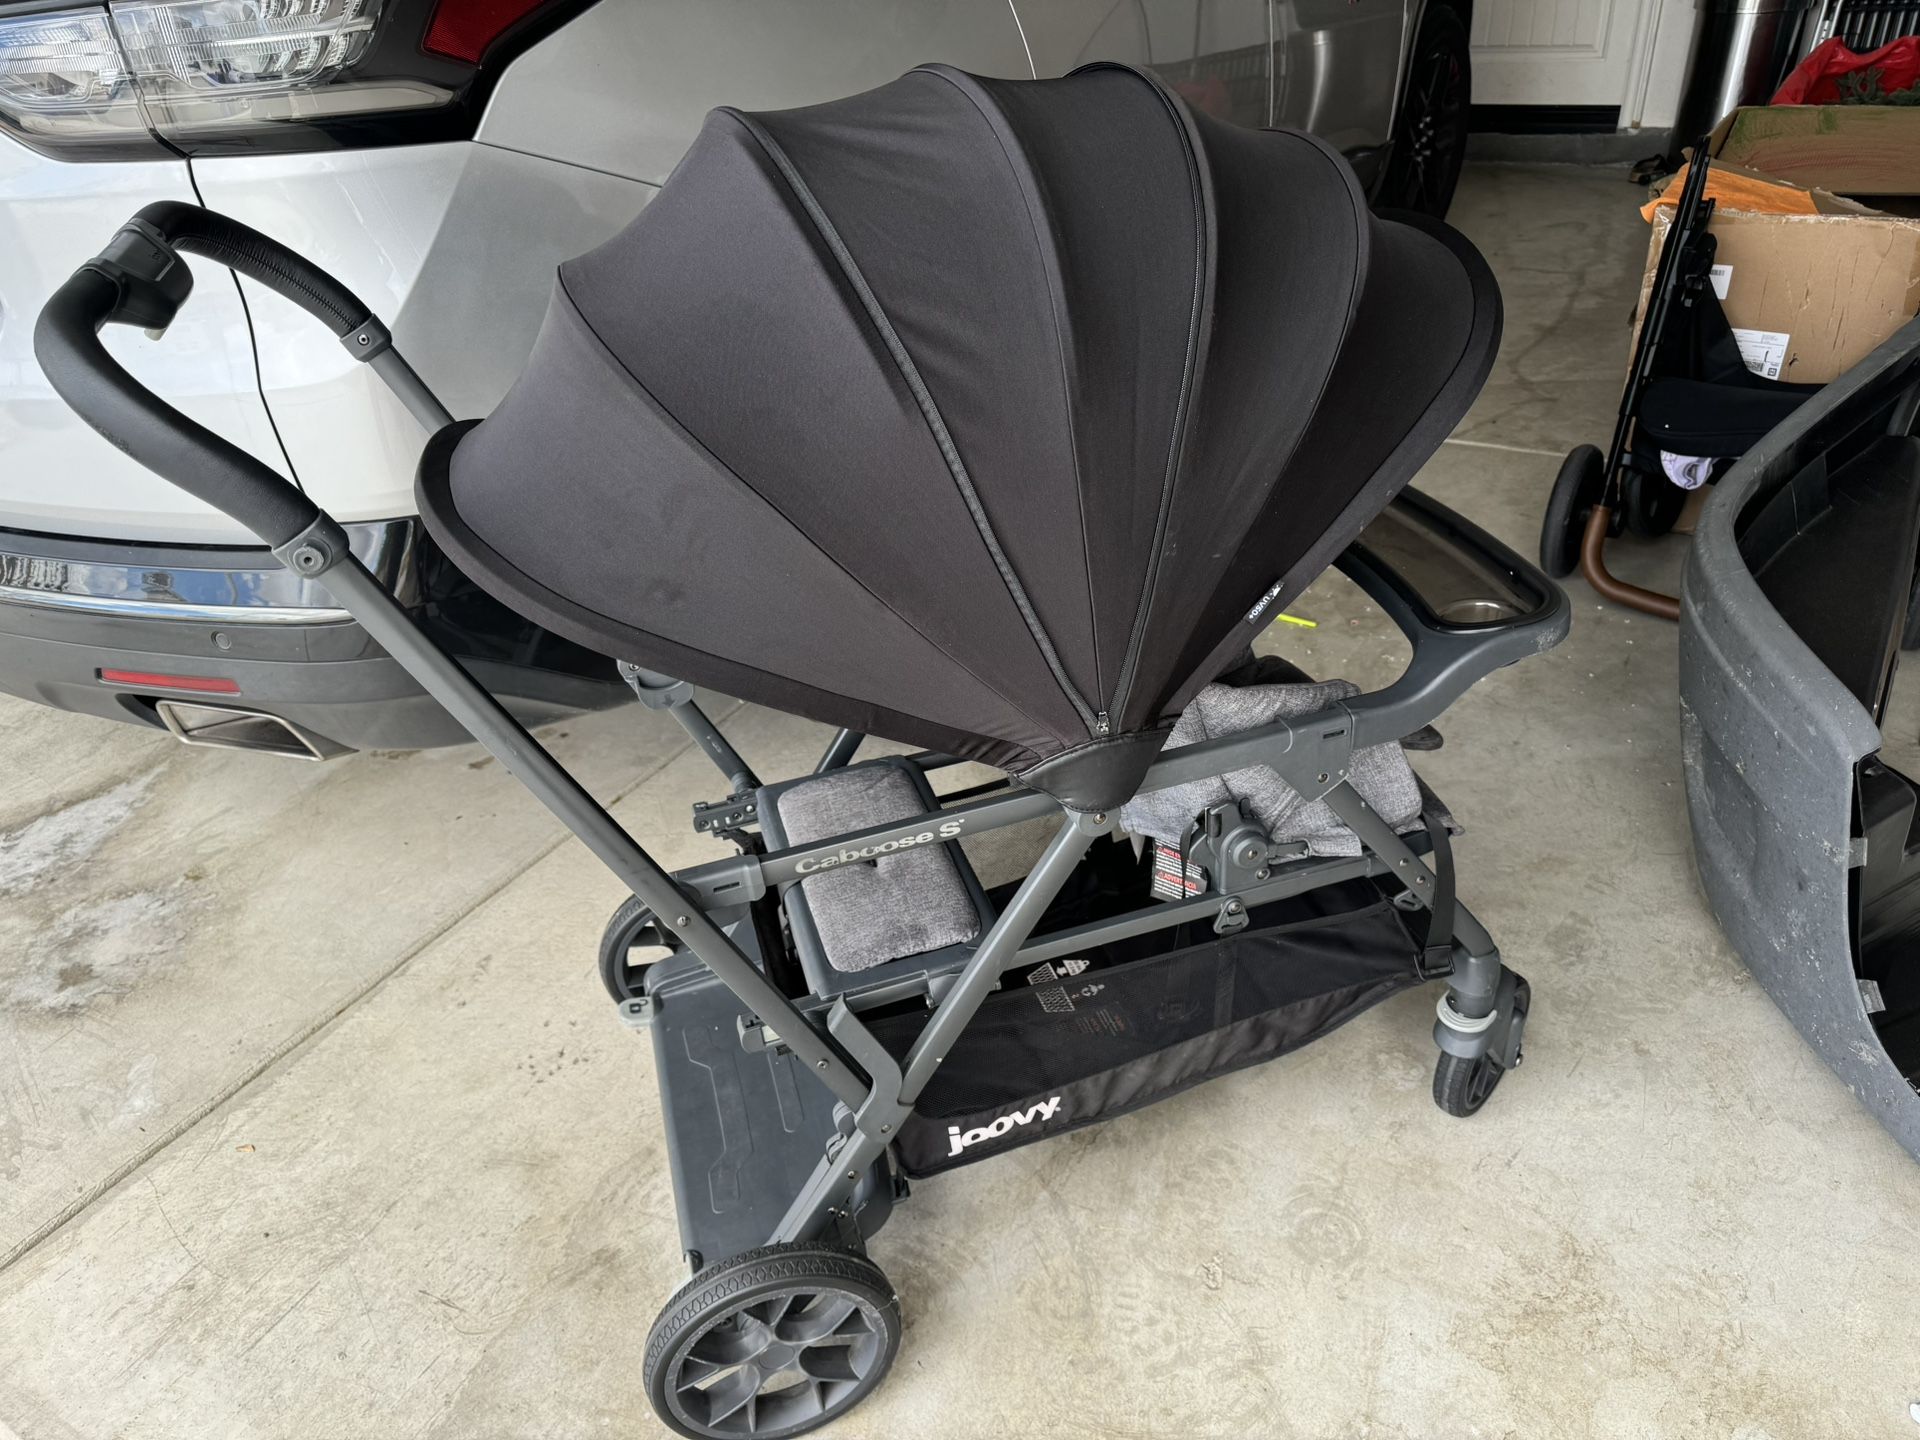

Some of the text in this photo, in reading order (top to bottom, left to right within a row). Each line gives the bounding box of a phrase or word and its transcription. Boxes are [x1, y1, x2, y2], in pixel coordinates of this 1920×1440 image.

[795, 820, 962, 873] Caboose S
[947, 1096, 1061, 1157] joovy
